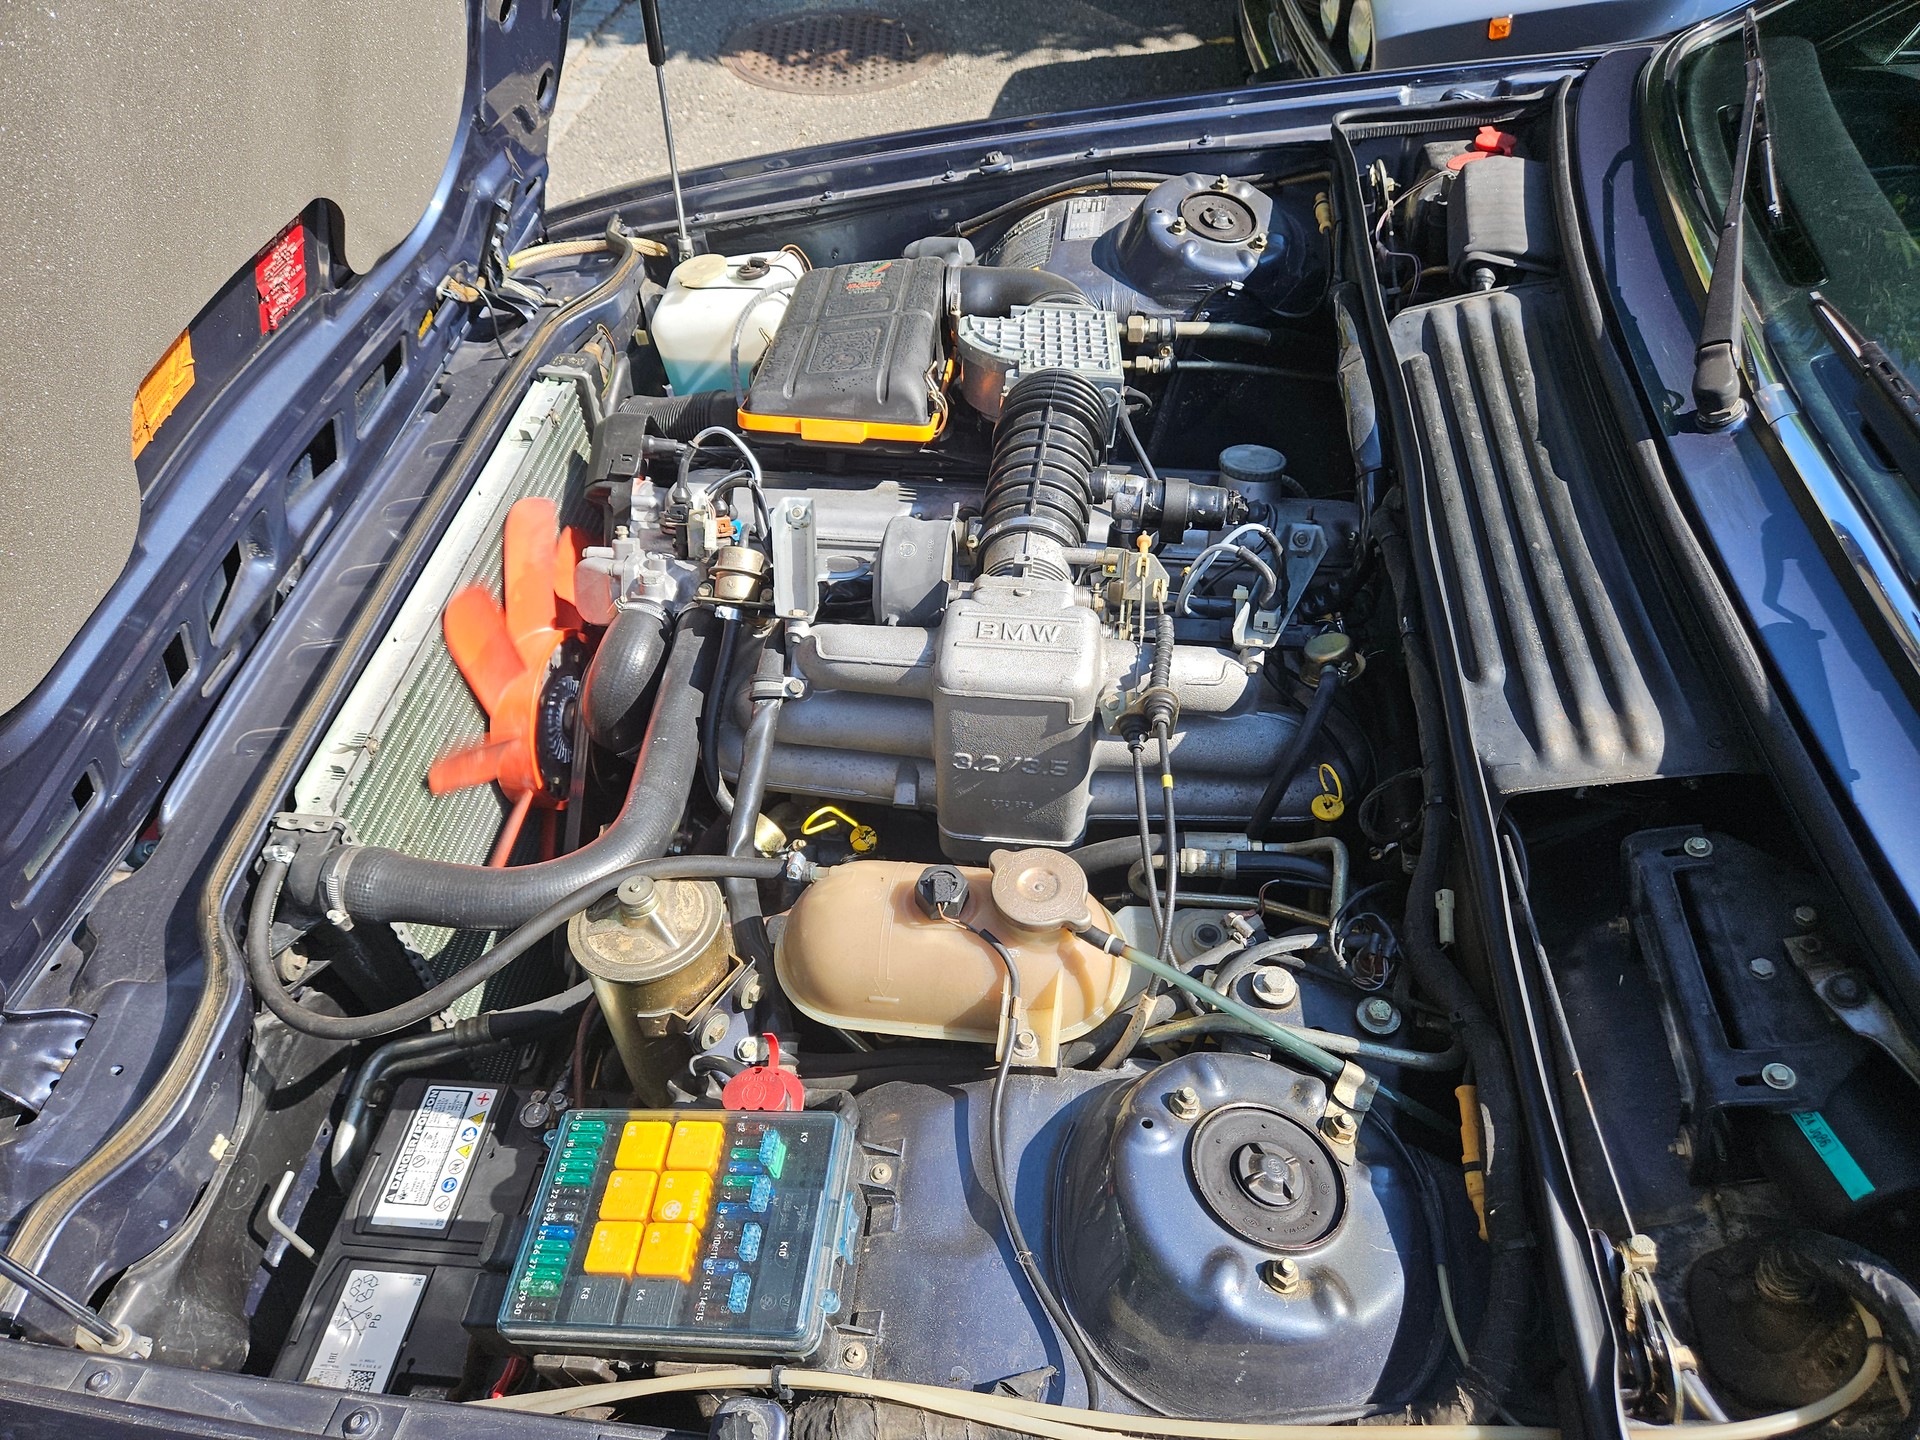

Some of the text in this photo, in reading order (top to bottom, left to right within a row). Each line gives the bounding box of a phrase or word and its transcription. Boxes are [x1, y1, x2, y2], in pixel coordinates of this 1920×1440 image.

[976, 621, 1062, 643] BMW
[952, 752, 1070, 777] 3.2/3.5
[575, 1112, 583, 1120] 16
[571, 1123, 580, 1131] 17
[389, 1089, 439, 1190] DANGER/POISON
[566, 1139, 575, 1147] 18
[800, 1132, 809, 1143] K9
[563, 1150, 573, 1158] 19
[559, 1163, 568, 1173] 20
[554, 1176, 563, 1185] 21
[614, 1176, 623, 1188] K6
[665, 1177, 674, 1189] K2
[550, 1189, 560, 1199] 22
[546, 1201, 556, 1213] 23
[717, 1221, 725, 1229] 9
[537, 1229, 549, 1241] 25
[651, 1231, 660, 1243] K3
[712, 1235, 722, 1245] 10
[533, 1243, 544, 1255] 26
[778, 1241, 789, 1257] K10
[528, 1257, 538, 1269] 27
[524, 1271, 534, 1282] 28
[706, 1267, 715, 1275] 12
[702, 1281, 711, 1291] 13
[518, 1290, 528, 1302] 29
[580, 1287, 592, 1300] K8
[635, 1288, 646, 1301] K4
[699, 1297, 708, 1305] 14
[514, 1303, 526, 1315] 30
[369, 1314, 382, 1329] Pb
[695, 1312, 704, 1322] 15
